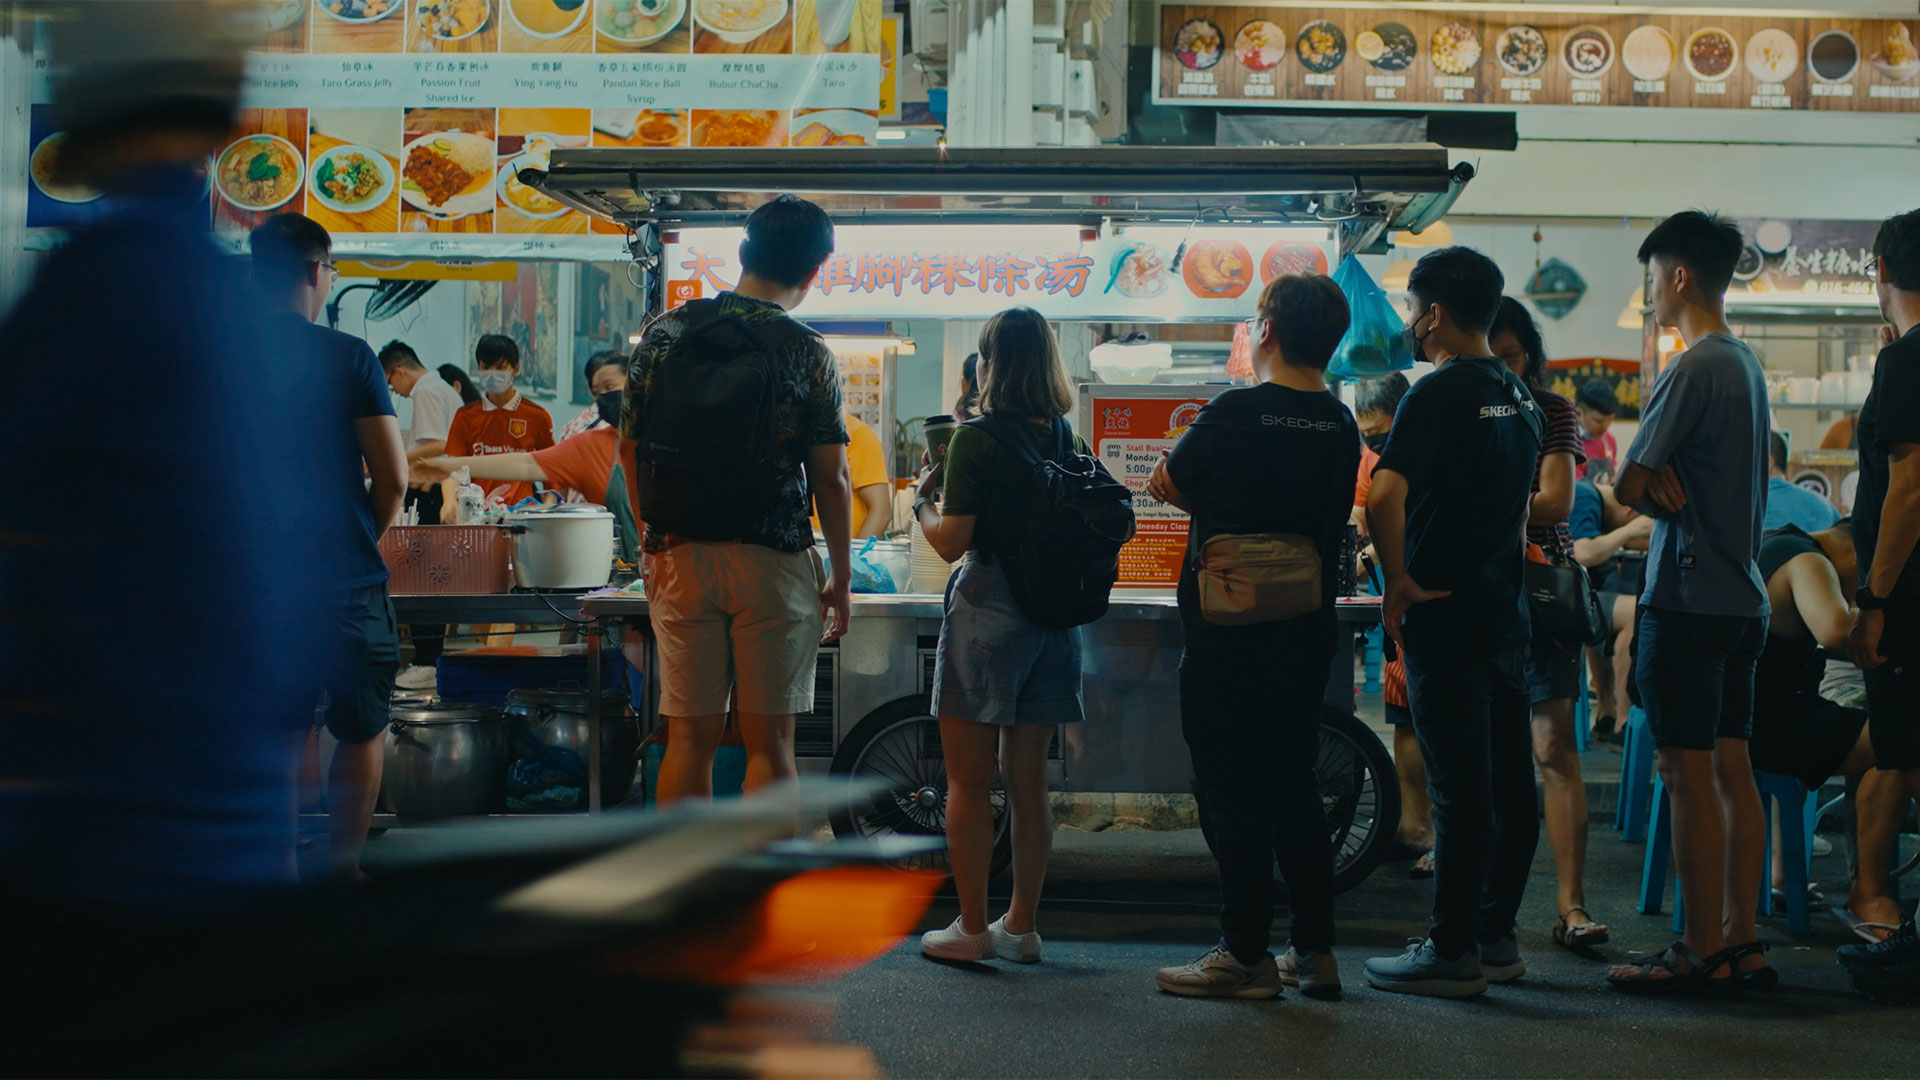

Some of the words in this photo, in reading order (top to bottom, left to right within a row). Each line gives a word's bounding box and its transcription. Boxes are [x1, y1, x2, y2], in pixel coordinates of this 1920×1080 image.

[264, 79, 278, 88] Ice
[280, 79, 299, 89] Jelly
[321, 79, 342, 88] Taro
[345, 79, 372, 88] Grass
[374, 79, 393, 89] Jelly
[421, 79, 456, 88] Passion
[459, 79, 481, 88] Fruit
[514, 79, 535, 89] Ying
[538, 79, 561, 89] Yang
[564, 79, 578, 88] Hu
[602, 79, 637, 88] Pandan
[640, 79, 660, 88] Rice
[663, 79, 681, 88] Ball
[709, 80, 737, 89] Bubur
[740, 80, 778, 90] ChaCha
[822, 78, 845, 88] Taro
[426, 93, 458, 103] Shared
[461, 94, 475, 103] Ice
[627, 94, 656, 105] Syrup
[1126, 444, 1144, 452] Stall
[1146, 444, 1174, 452] Busine
[1126, 454, 1159, 463] Monday
[1126, 464, 1153, 476] 5:00p
[1125, 479, 1144, 489] Shop
[1136, 522, 1169, 531] dnesday
[1170, 522, 1189, 530] Close
